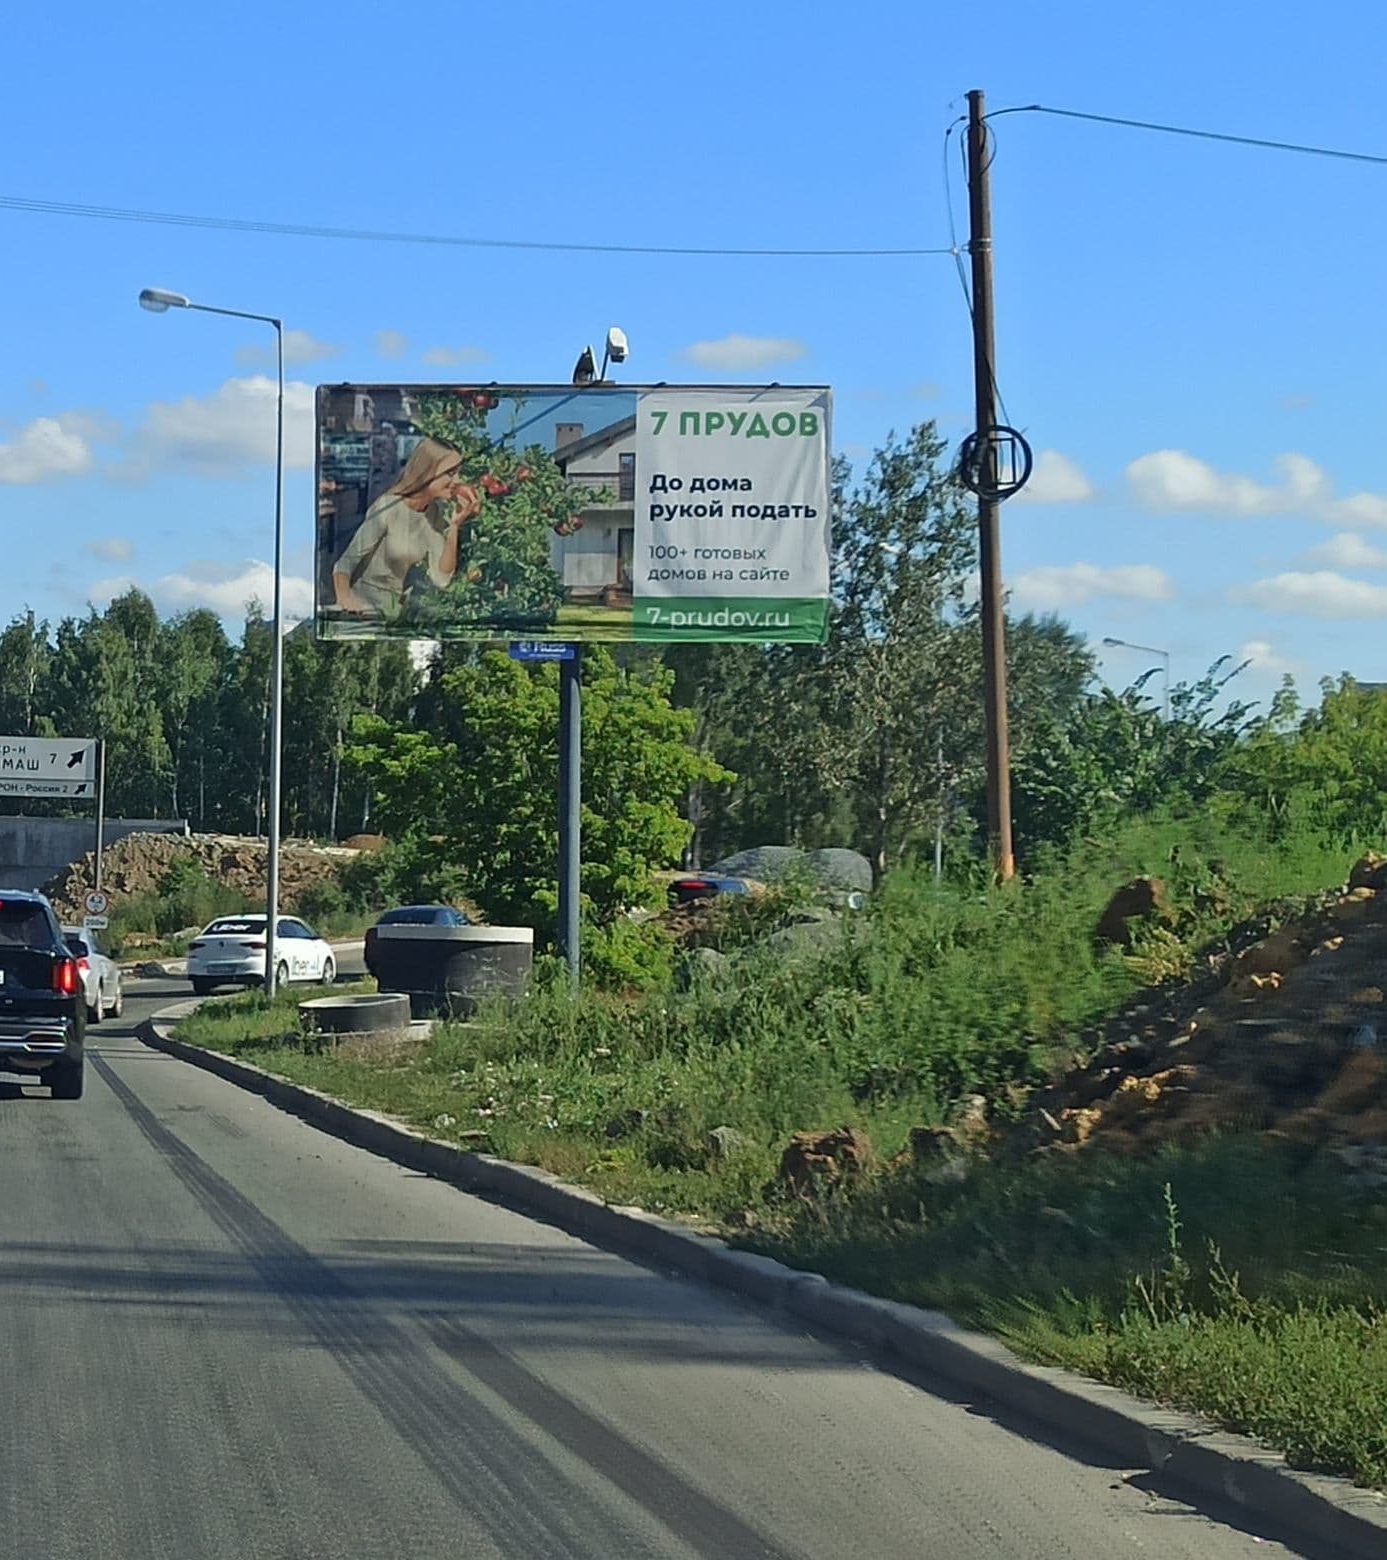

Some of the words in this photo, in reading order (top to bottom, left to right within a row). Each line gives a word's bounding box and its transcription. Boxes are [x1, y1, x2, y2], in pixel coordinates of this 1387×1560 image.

[650, 411, 669, 436] 7
[679, 411, 819, 438] ПРУДОВ
[649, 474, 683, 494] До
[689, 477, 752, 494] дома
[649, 500, 723, 522] рукой
[731, 504, 817, 520] подать
[648, 545, 688, 560] 100+
[693, 547, 766, 560] готовых
[647, 568, 707, 582] домов
[712, 569, 734, 581] на
[739, 566, 790, 581] сайте
[646, 607, 790, 630] 7-prudov.ru
[49, 753, 57, 764] 7
